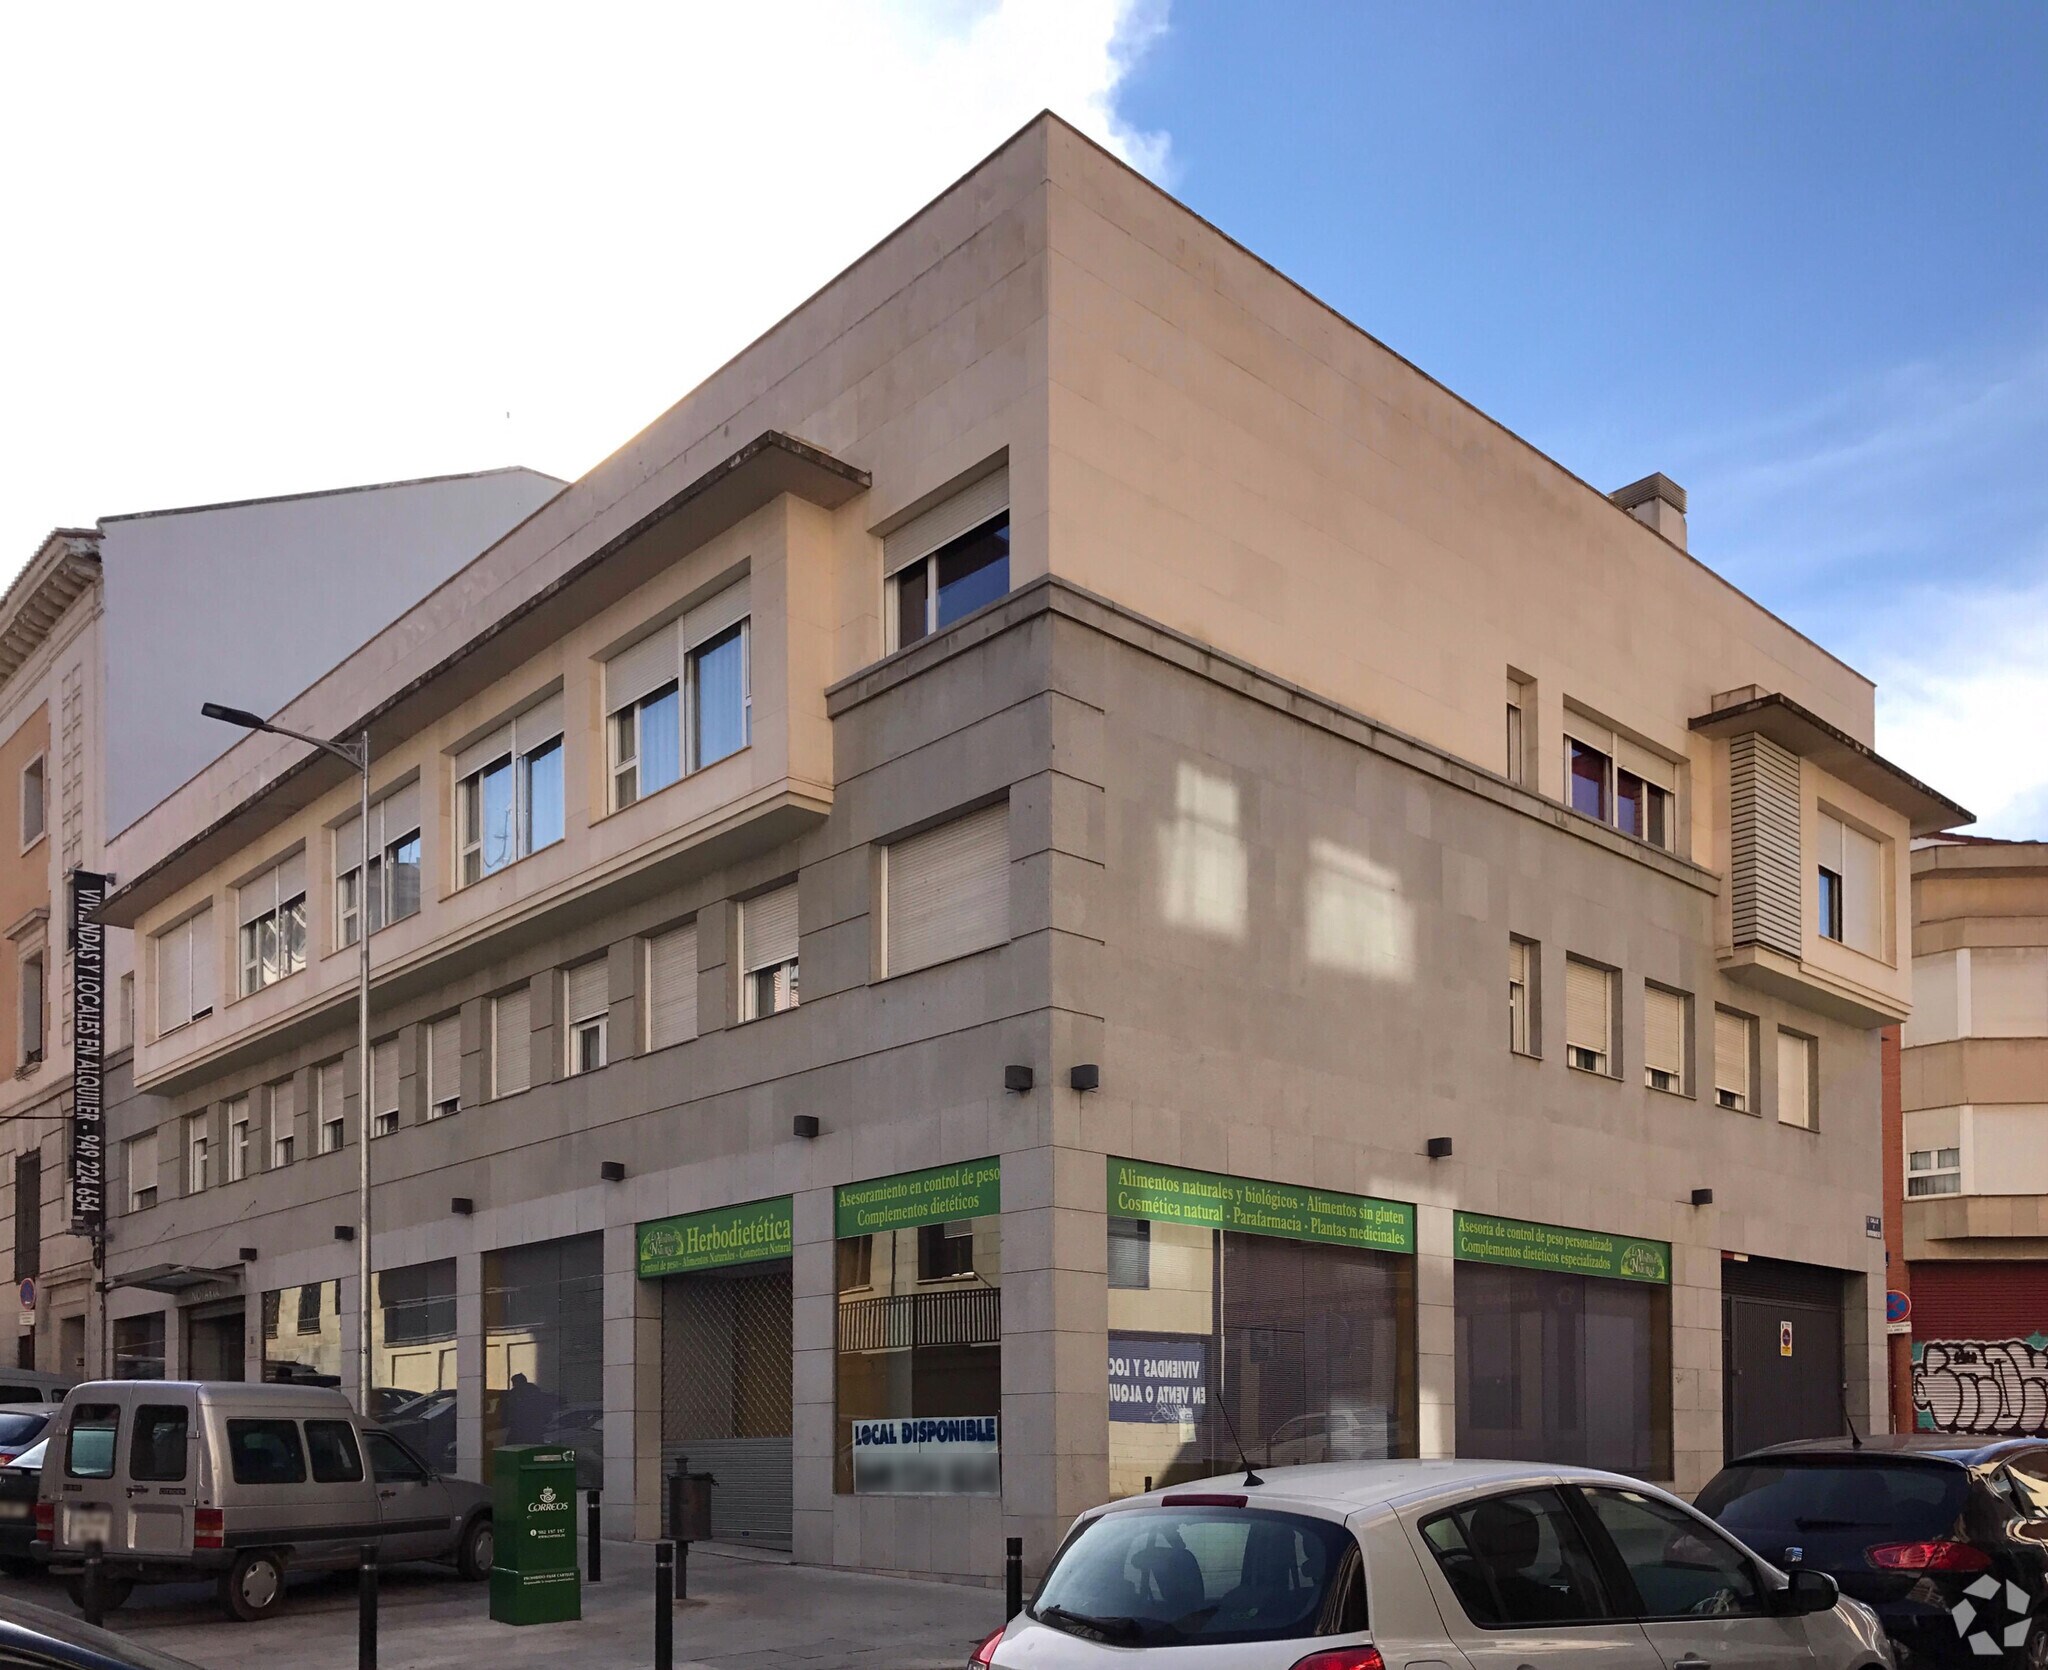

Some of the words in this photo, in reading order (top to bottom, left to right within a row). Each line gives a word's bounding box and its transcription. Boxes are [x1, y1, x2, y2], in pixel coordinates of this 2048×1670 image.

[78, 889, 101, 960] VIVNDAS
[77, 965, 100, 973] Y
[77, 975, 100, 1035] LOCALES
[77, 1037, 100, 1056] EN
[76, 1058, 100, 1121] ALQUILER
[76, 1135, 100, 1158] 949
[76, 1160, 100, 1184] 224
[839, 1183, 907, 1207] Asesoramiento
[910, 1182, 921, 1194] en
[924, 1170, 959, 1193] control
[962, 1168, 974, 1185] de
[977, 1167, 1000, 1187] peso
[76, 1187, 99, 1212] 654
[857, 1202, 928, 1227] Complementos
[930, 1193, 979, 1214] dietéticos
[1118, 1167, 1180, 1192] Alimentos
[1182, 1182, 1233, 1200] naturales
[1236, 1190, 1243, 1205] y
[1245, 1186, 1298, 1210] biológicos
[1307, 1195, 1357, 1218] Alimentos
[1359, 1203, 1373, 1220] sin
[1375, 1206, 1404, 1225] gluten
[687, 1213, 791, 1254] Herbodietética
[1118, 1191, 1180, 1216] Cosmética
[1184, 1204, 1224, 1221] natural
[1233, 1206, 1302, 1231] Parafarmacia
[1311, 1217, 1347, 1238] Plantas
[1349, 1223, 1405, 1245] medicinales
[1461, 1237, 1521, 1258] Complementos
[1561, 1252, 1611, 1270] especializados
[1495, 1222, 1505, 1237] de
[1507, 1227, 1535, 1242] control
[1536, 1229, 1545, 1243] de
[1547, 1233, 1564, 1246] peso
[1565, 1237, 1613, 1253] personalizada
[855, 1422, 897, 1446] LOCAL
[901, 1418, 996, 1444] DISPONIBLE
[528, 1502, 569, 1512] CORREOS
